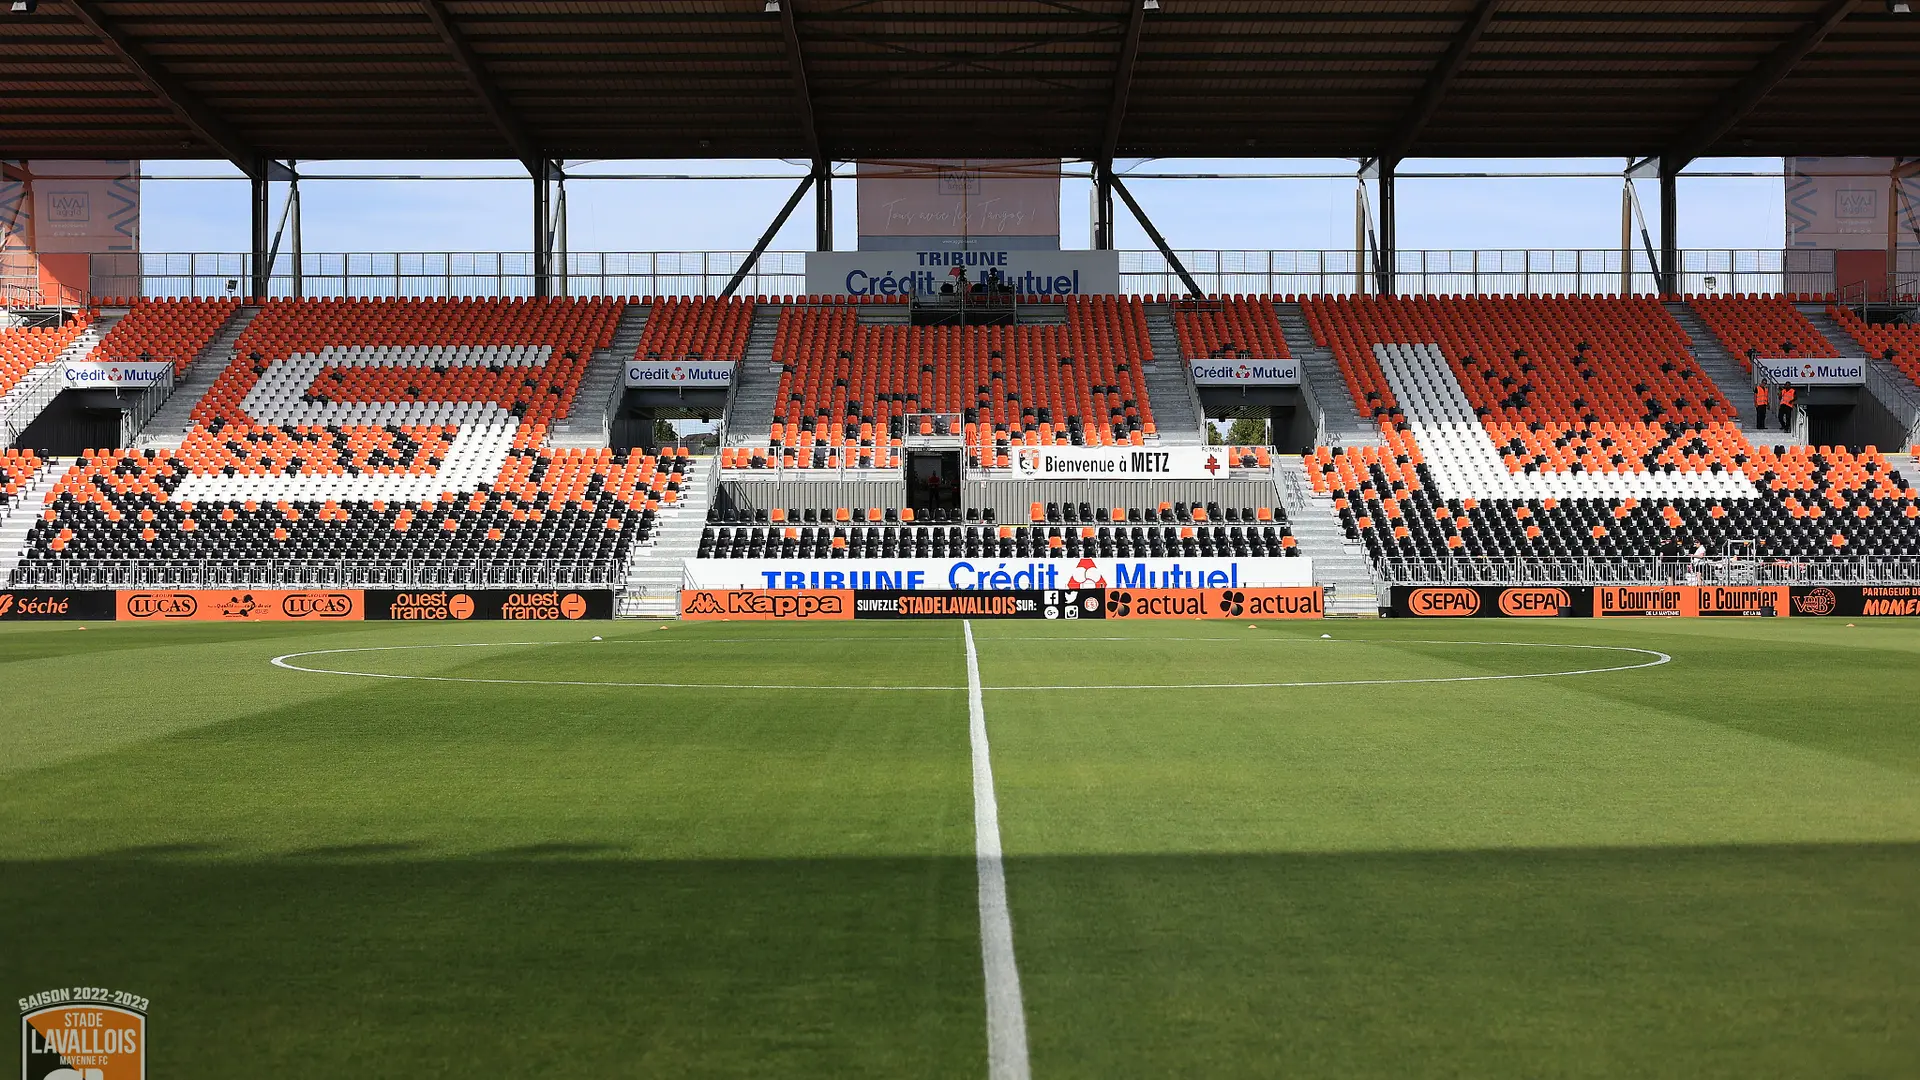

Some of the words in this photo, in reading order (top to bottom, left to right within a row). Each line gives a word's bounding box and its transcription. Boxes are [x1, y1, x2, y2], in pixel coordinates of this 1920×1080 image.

[53, 196, 84, 210] LAVAL
[1840, 195, 1871, 206] LAVAL
[56, 209, 82, 217] agglo
[882, 197, 917, 232] Tous
[919, 210, 950, 223] avec
[977, 197, 1026, 232] Tangos
[916, 251, 1008, 266] TRIBUNE
[846, 269, 935, 295] Crédit
[66, 368, 105, 381] Crédit
[629, 367, 669, 380] Crédit
[688, 368, 732, 380] Mutuel
[1194, 366, 1233, 378] Crédit
[1253, 366, 1296, 378] Mutuel
[1760, 365, 1798, 378] Crédit
[1817, 365, 1862, 378] Mutuel
[1045, 456, 1115, 473] Bienvenue
[1119, 456, 1127, 473] à
[1131, 452, 1170, 473] METZ
[762, 571, 925, 590] TRIBUNE
[948, 562, 1059, 590] Crédit
[1116, 562, 1238, 589] Mutuel
[397, 591, 447, 606] ouest
[508, 591, 559, 606] ouest
[1601, 588, 1613, 609] le
[1619, 587, 1681, 609] Courrier
[1698, 588, 1710, 609] le
[1716, 587, 1778, 609] Courrier
[1862, 587, 1910, 596] PARTAGEUR
[17, 597, 70, 614] Séché
[134, 599, 191, 613] LUCAS
[288, 599, 346, 613] LUCAS
[728, 592, 842, 617] Kappa
[1016, 599, 1037, 611] SUR:
[1136, 592, 1208, 615] actual
[1249, 590, 1321, 614] actual
[1421, 593, 1476, 610] SEPAL
[390, 603, 447, 620] france
[501, 603, 559, 620] france
